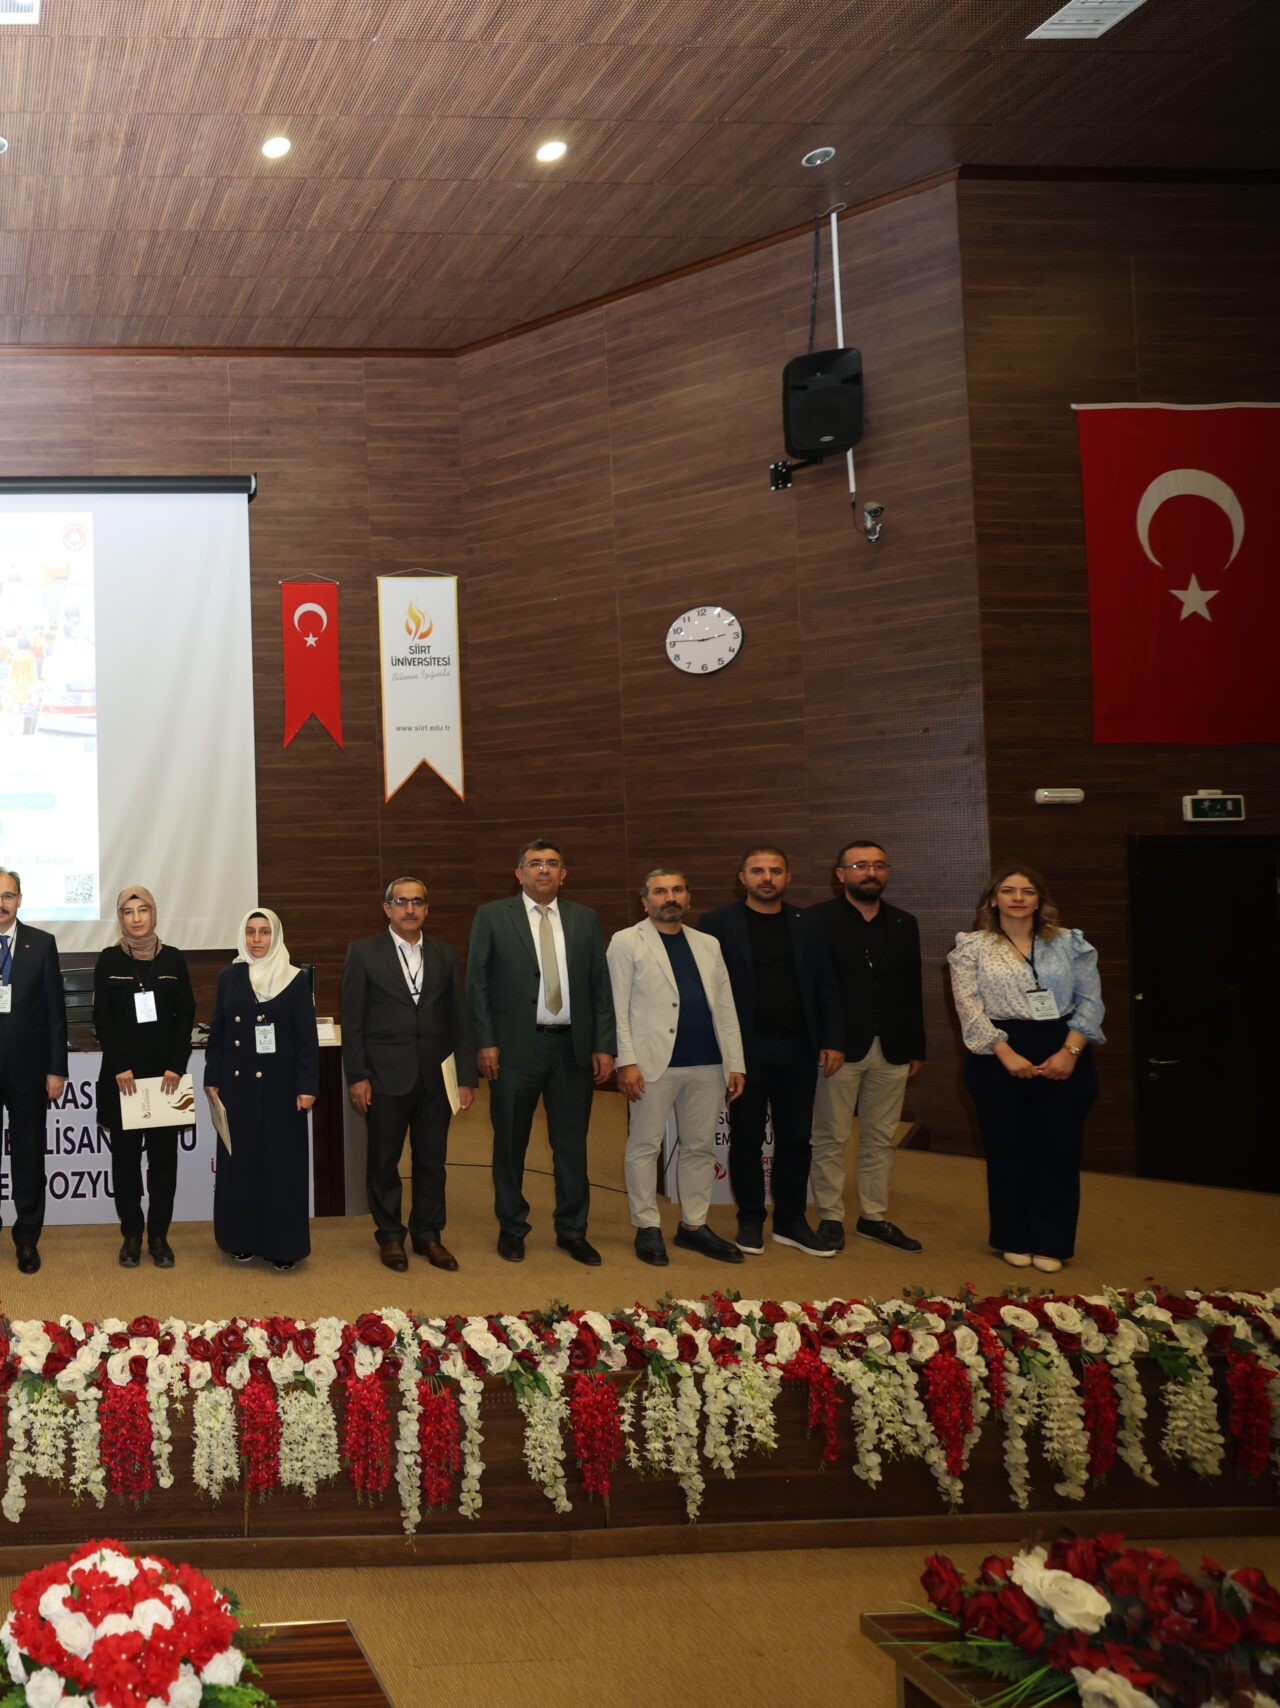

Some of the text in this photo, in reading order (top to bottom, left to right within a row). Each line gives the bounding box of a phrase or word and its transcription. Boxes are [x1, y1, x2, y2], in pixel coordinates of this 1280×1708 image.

[696, 608, 707, 617] 12
[672, 627, 683, 635] 10
[408, 644, 432, 655] SİİRT
[390, 655, 451, 667] ÜNİVERSİTESİ
[717, 658, 725, 666] 5
[395, 724, 451, 732] www.siirt.edu.tr
